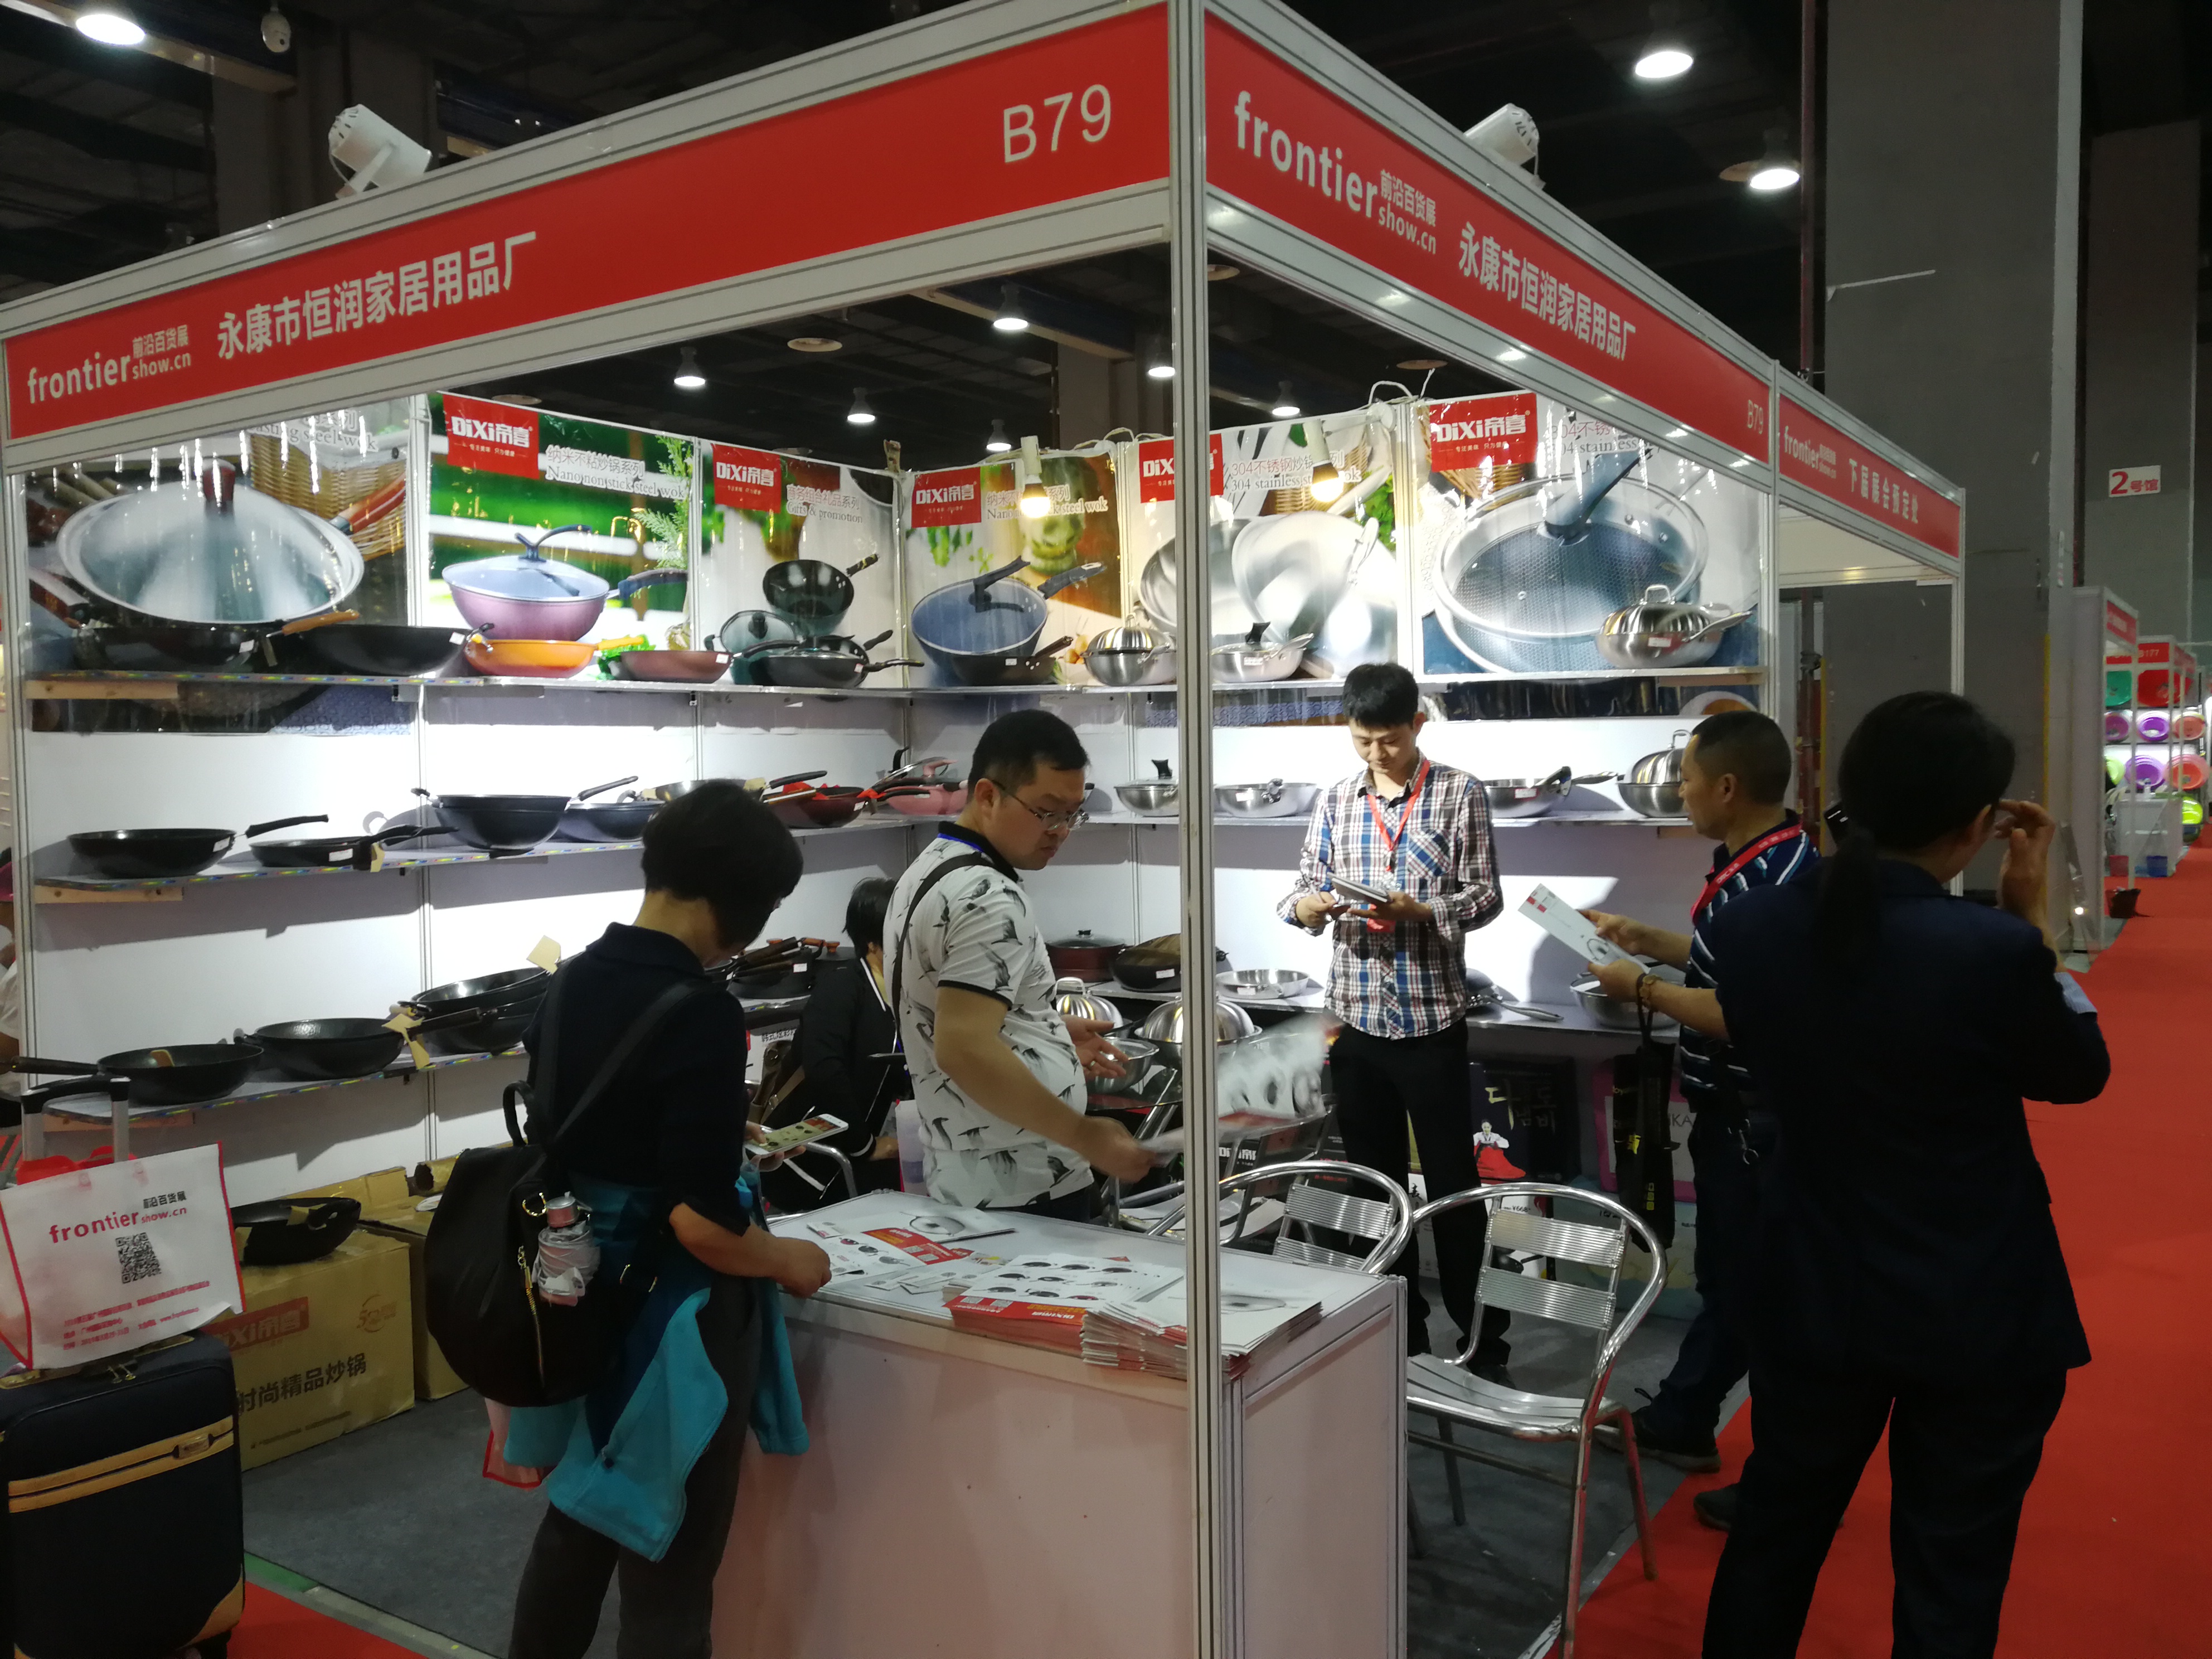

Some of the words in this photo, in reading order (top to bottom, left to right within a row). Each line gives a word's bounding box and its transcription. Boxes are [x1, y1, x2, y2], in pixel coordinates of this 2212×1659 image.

[1003, 84, 1111, 163] B79
[1234, 90, 1377, 219] frontier
[1379, 205, 1437, 254] show.cn
[1380, 169, 1437, 226] 前沿百货展
[217, 231, 537, 360] 永康市恒润家居用品厂
[1459, 221, 1636, 361] 永康市恒润家居用品厂
[132, 324, 189, 360] 前沿百货展
[27, 352, 132, 405] frontier
[132, 350, 192, 382] show.cn
[1747, 400, 1764, 434] B79
[303, 430, 336, 445] seel
[1784, 425, 1819, 469] frontier
[547, 447, 645, 478] 纳米不粘炒锅系列
[547, 465, 581, 482] Nano
[584, 475, 605, 487] non
[608, 477, 631, 490] stick
[636, 482, 657, 495] steel
[660, 486, 685, 498] wok
[1231, 479, 1251, 491] 304
[1255, 475, 1301, 489] stainless
[2111, 471, 2158, 495] 2号馆
[819, 510, 862, 523] promotion
[987, 508, 1013, 520] Nano
[1062, 498, 1083, 512] steel
[1085, 496, 1107, 511] wok
[49, 1212, 139, 1243] frontier
[142, 1207, 187, 1224] show.cn
[237, 1352, 367, 1414] 时尚精品炒锅
